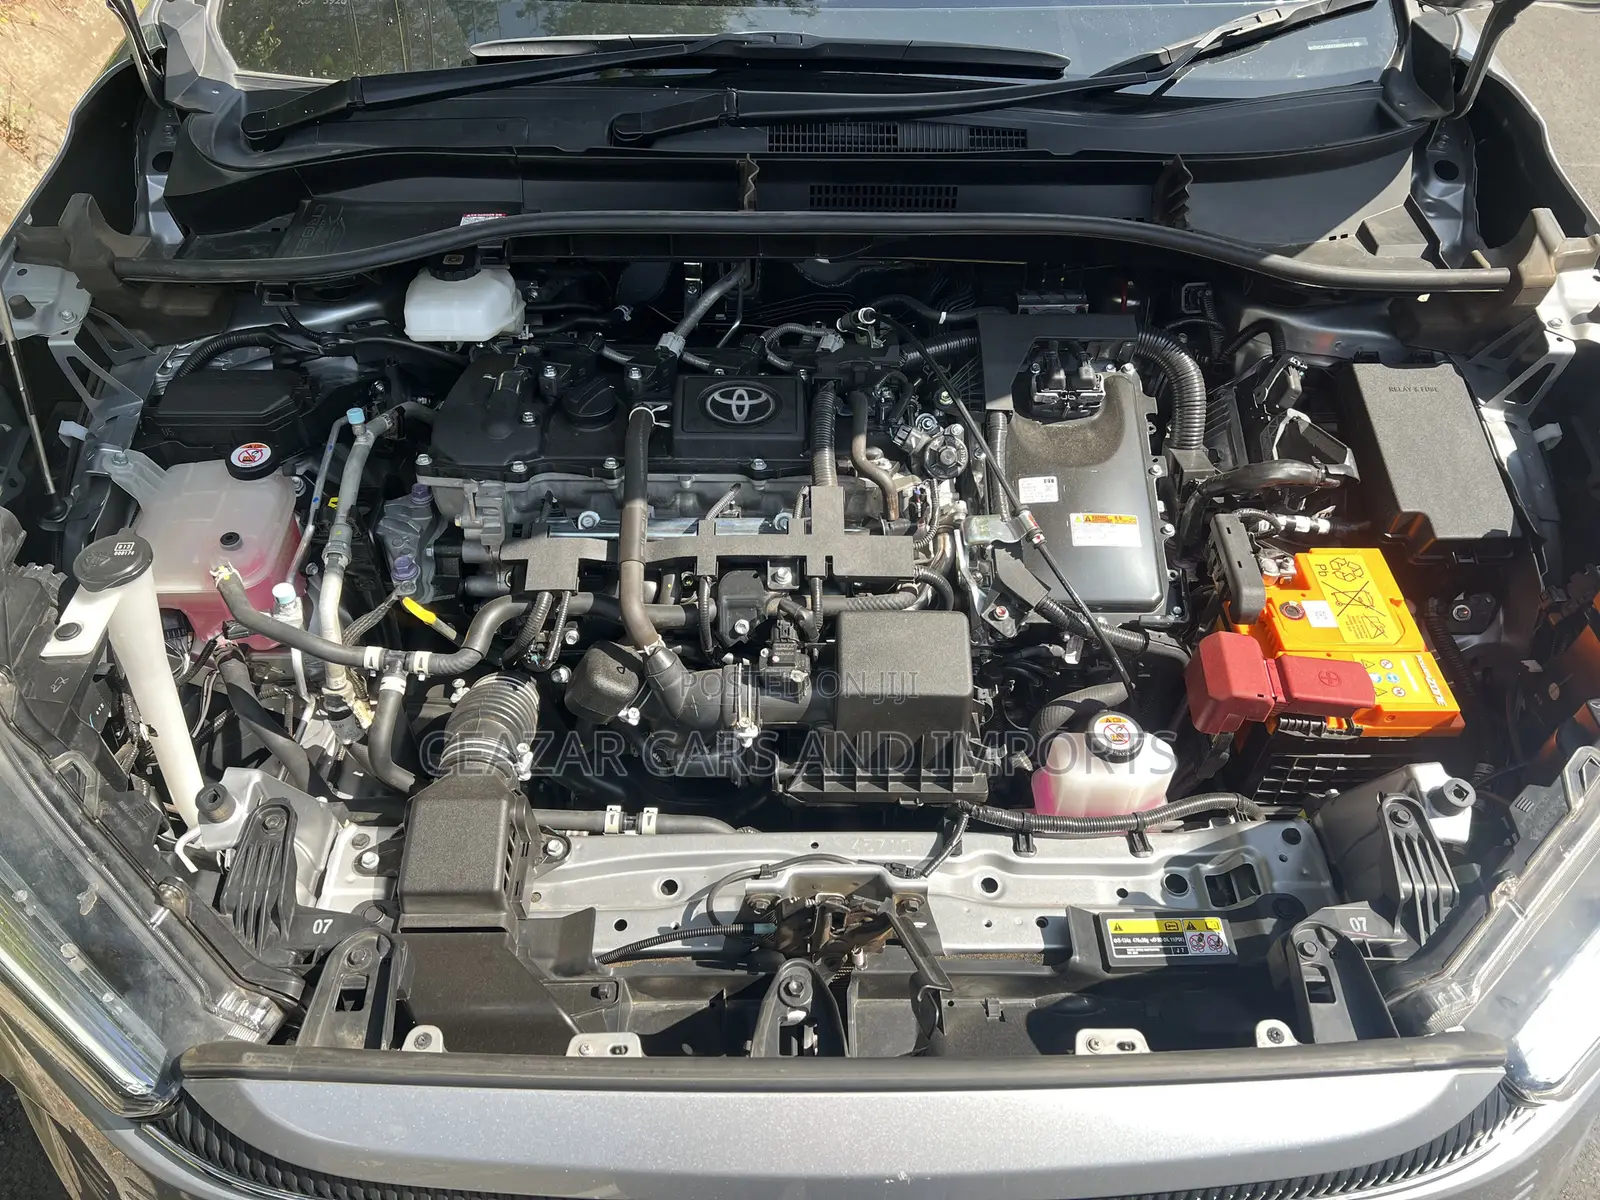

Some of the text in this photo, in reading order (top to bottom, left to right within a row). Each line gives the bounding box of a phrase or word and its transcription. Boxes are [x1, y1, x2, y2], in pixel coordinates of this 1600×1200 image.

[1315, 563, 1329, 577] Pb
[313, 918, 333, 934] 07
[1349, 916, 1367, 932] 07
